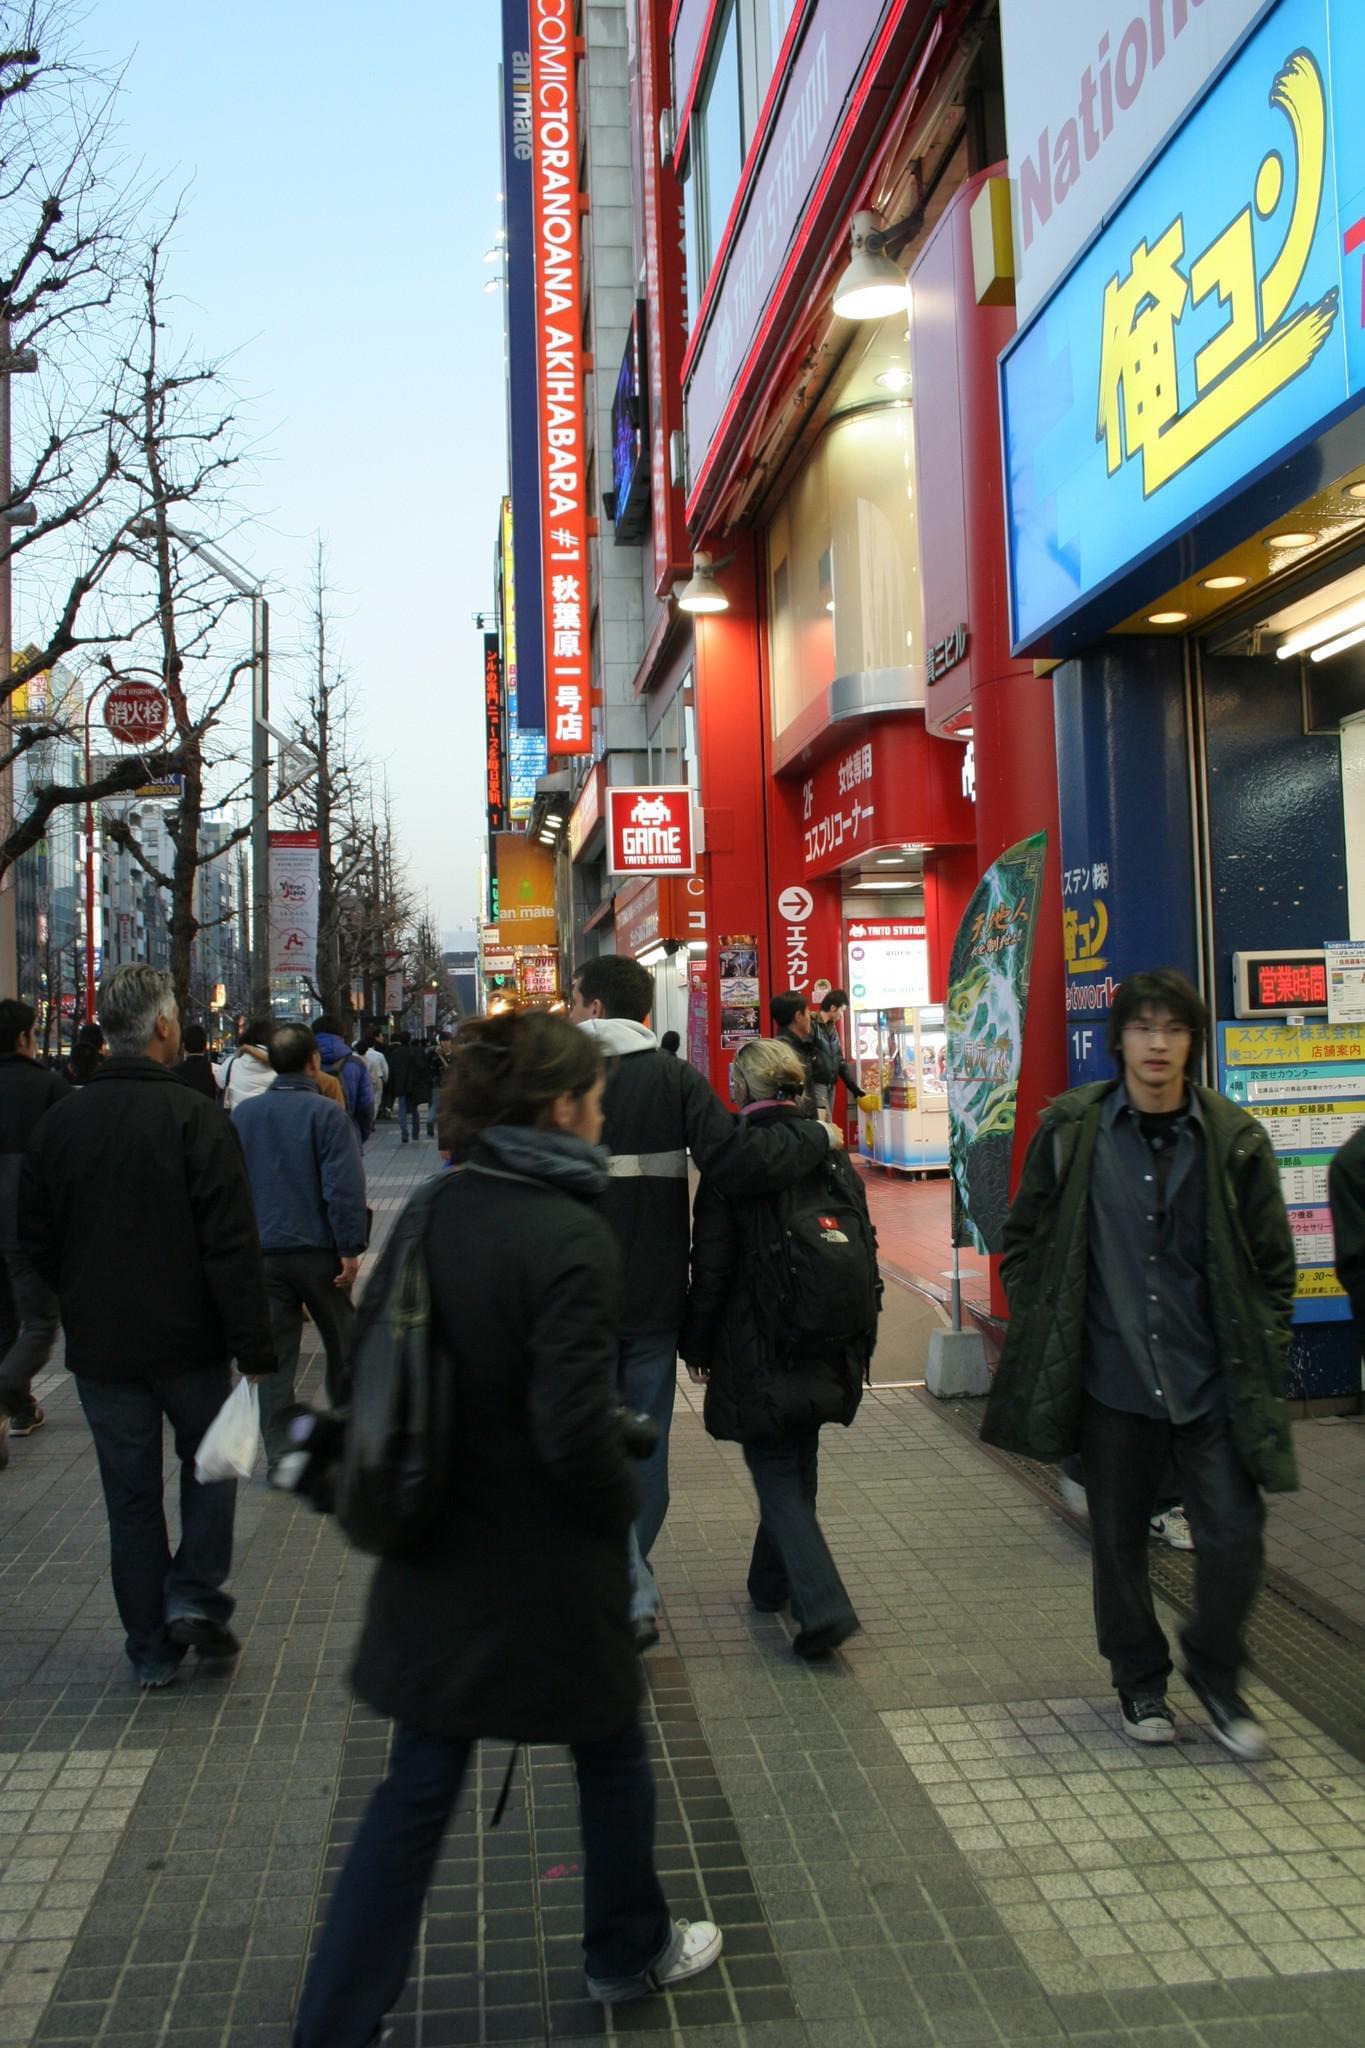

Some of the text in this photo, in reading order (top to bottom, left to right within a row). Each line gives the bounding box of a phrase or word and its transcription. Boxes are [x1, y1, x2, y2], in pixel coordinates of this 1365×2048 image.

[1019, 0, 1204, 253] Nation
[545, 326, 579, 518] AKIHABARA
[550, 527, 580, 561] #1
[109, 700, 164, 725] 消火栓
[803, 743, 873, 821] 2F 女性専用
[622, 826, 682, 855] GAME
[804, 799, 875, 863] コスプリコーナー
[624, 854, 682, 865] TAITO STATION
[867, 926, 891, 936] TAITO
[786, 925, 809, 993] エスカレ
[1259, 964, 1327, 1005] 営業時間
[1072, 1030, 1093, 1060] 1F
[1311, 1044, 1361, 1059] 店舗案内
[1250, 1069, 1318, 1081] 取寄せカウンター
